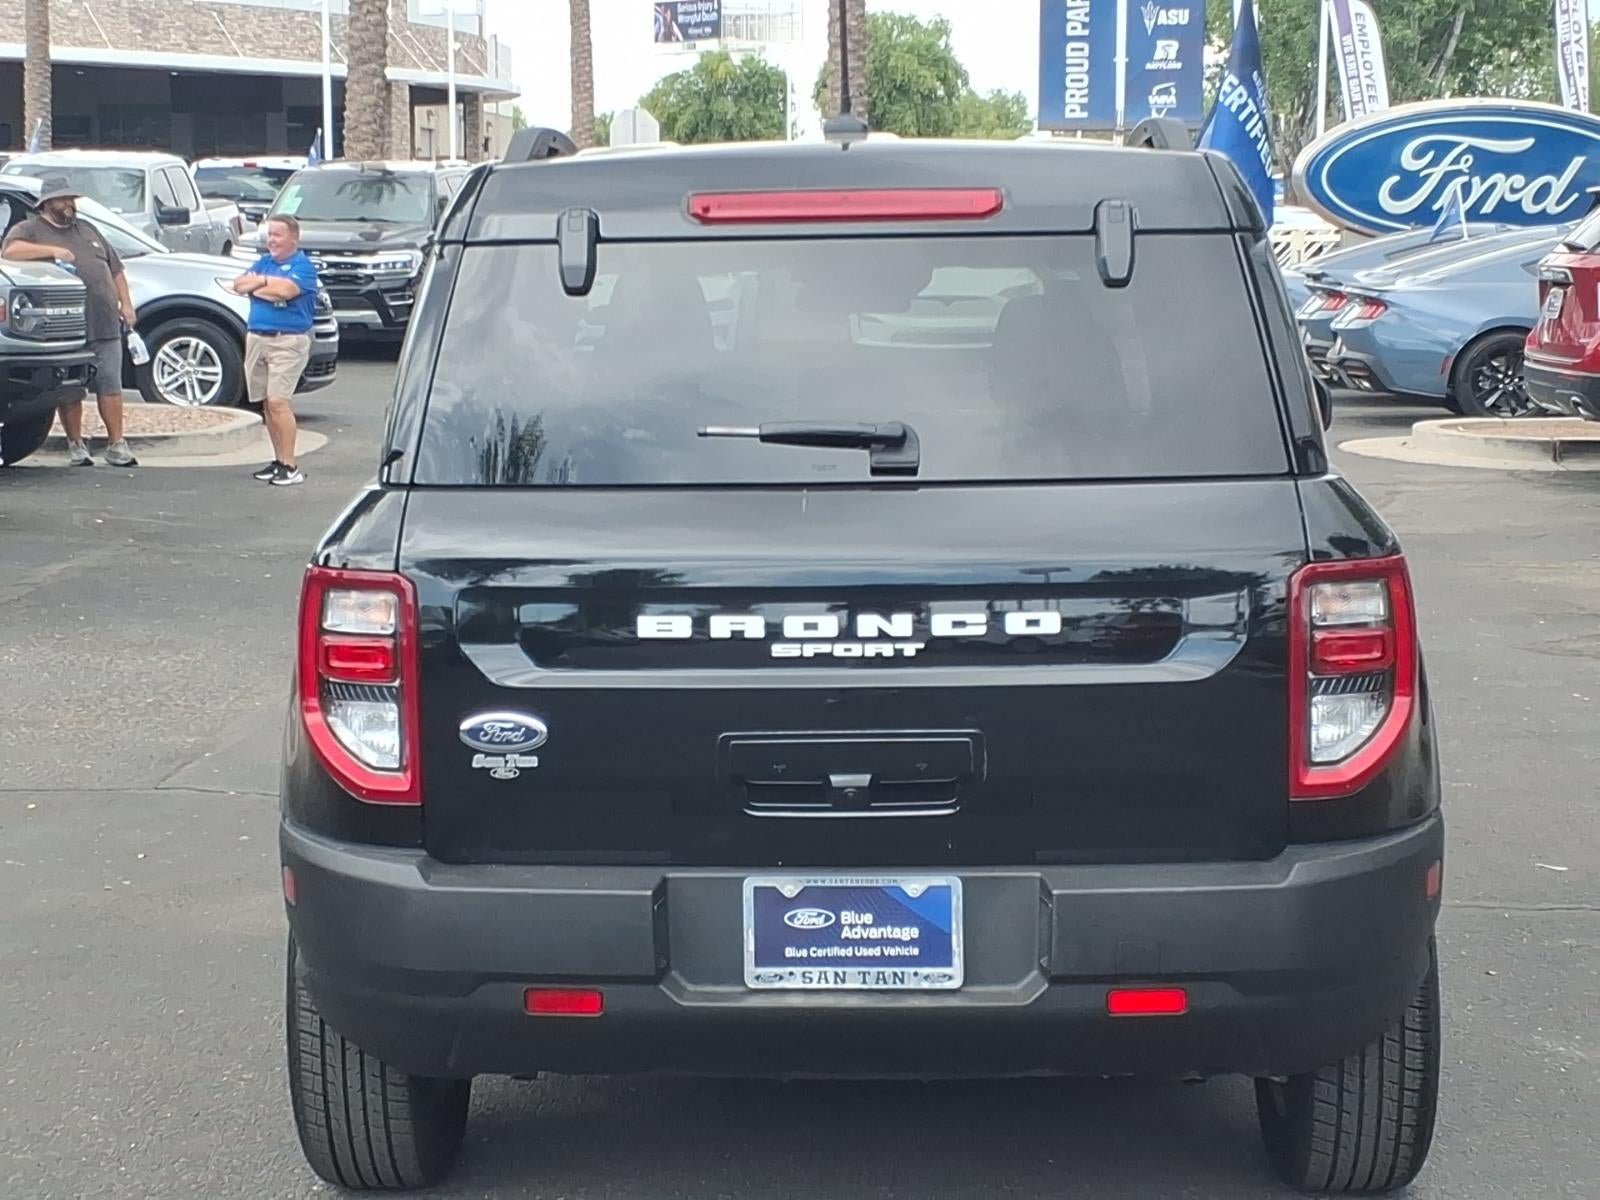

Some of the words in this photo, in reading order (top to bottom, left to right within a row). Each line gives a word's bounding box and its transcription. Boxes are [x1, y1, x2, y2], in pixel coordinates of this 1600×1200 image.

[1157, 9, 1190, 25] ASU
[1354, 12, 1379, 105] EMPLOYEE
[1065, 42, 1090, 118] PROUD
[1218, 70, 1272, 178] ERTIFIED
[1377, 133, 1588, 216] Ford
[636, 611, 1062, 639] BRONCO
[770, 642, 926, 658] SPORT
[479, 721, 526, 742] Ford
[793, 912, 826, 925] Ford
[841, 911, 873, 925] Blue
[841, 925, 920, 941] Advantage
[784, 946, 808, 958] Blue
[809, 946, 853, 957] Certified
[854, 946, 881, 957] Used
[882, 946, 919, 956] Vehicle
[802, 970, 846, 984] SAN
[857, 970, 906, 984] TAN
